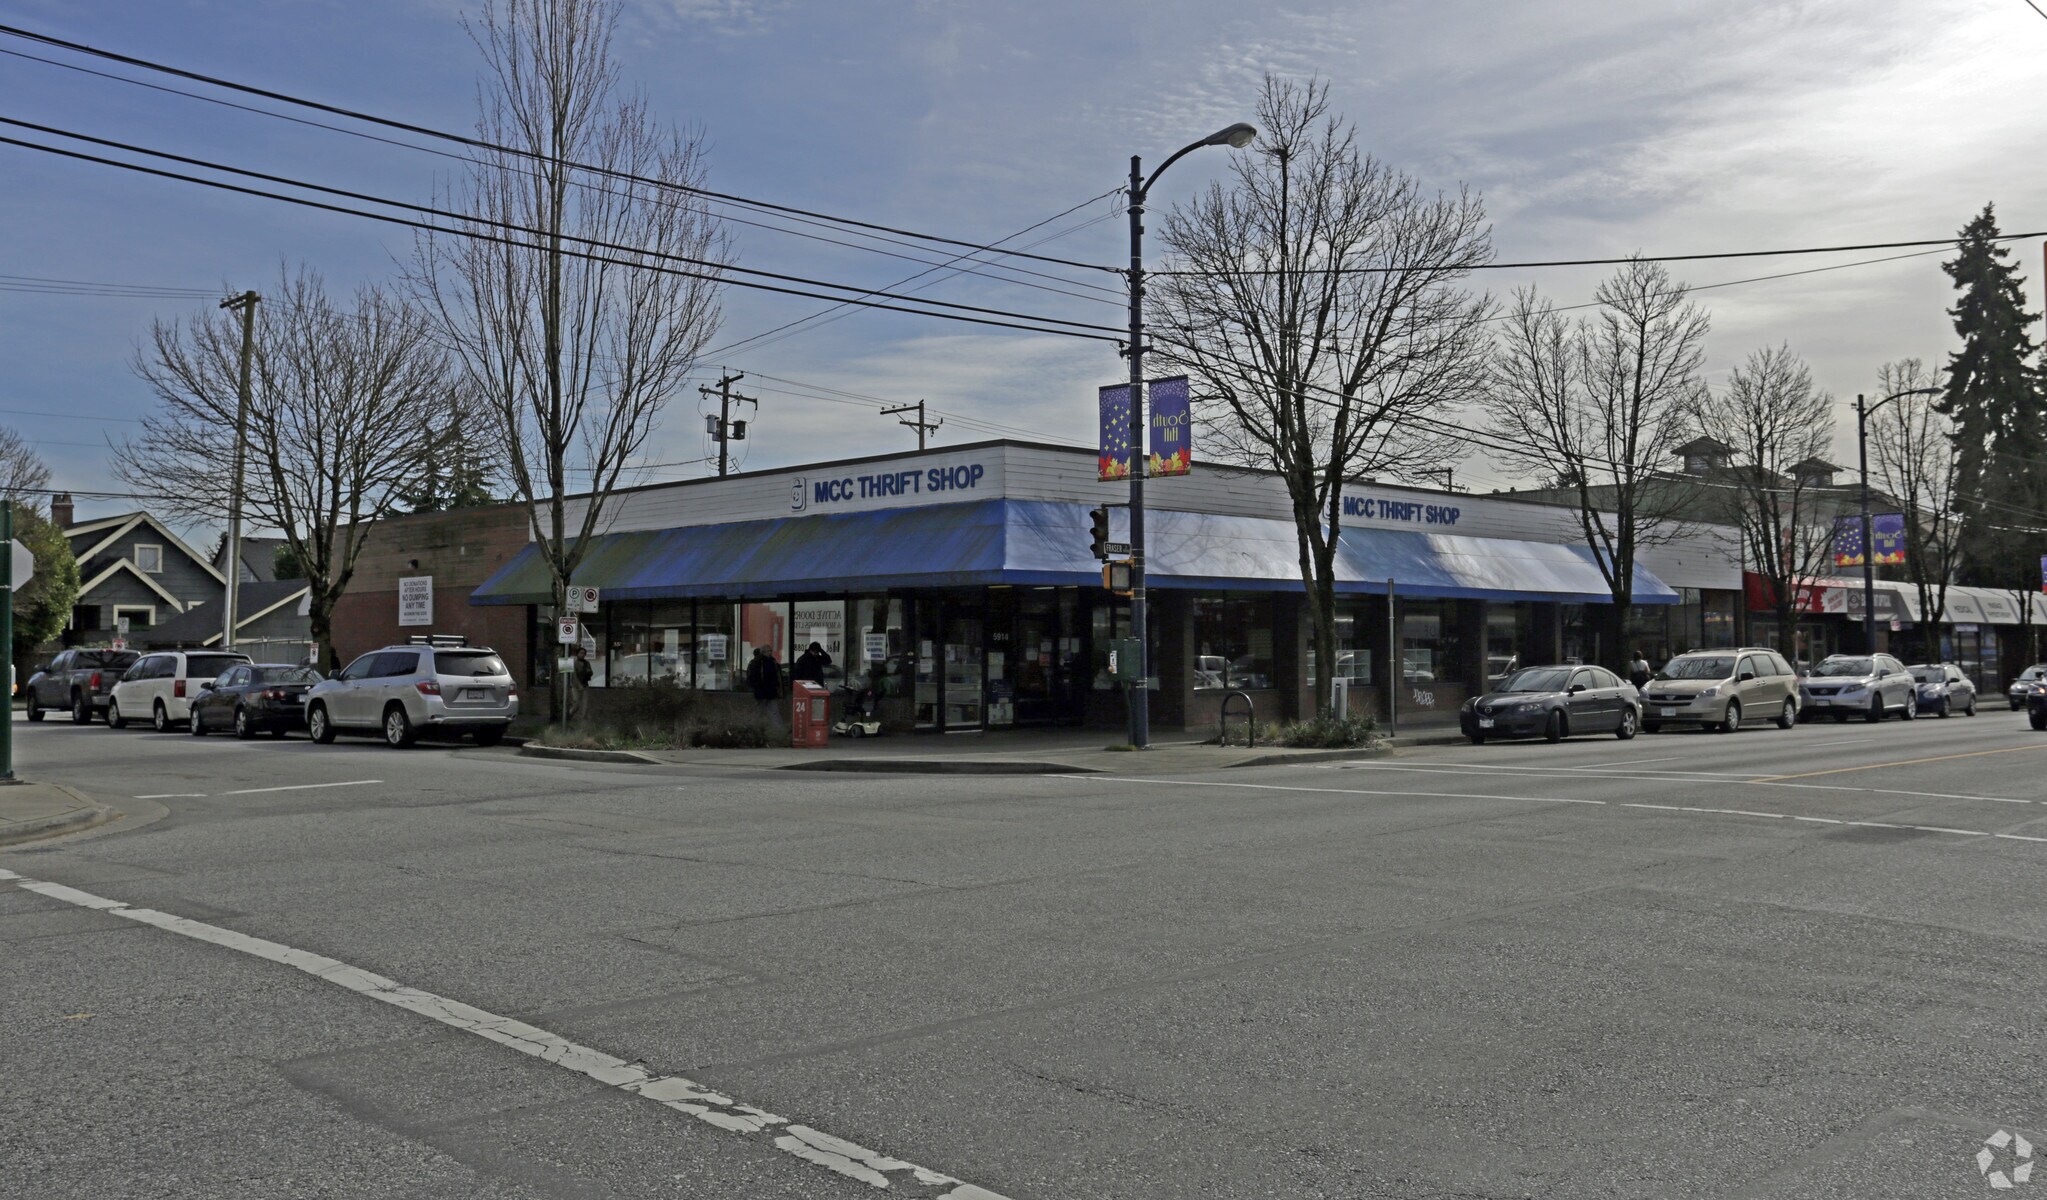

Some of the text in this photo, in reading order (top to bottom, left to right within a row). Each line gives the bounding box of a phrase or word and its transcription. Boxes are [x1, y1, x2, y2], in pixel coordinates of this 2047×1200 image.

[814, 464, 984, 503] MCC THRIFT SHOP
[1343, 496, 1460, 525] MCC THRIFT SHOP
[1106, 543, 1122, 553] FRASER
[409, 593, 429, 601] DUMPING
[993, 632, 1009, 641] 5914
[796, 701, 806, 712] 24
